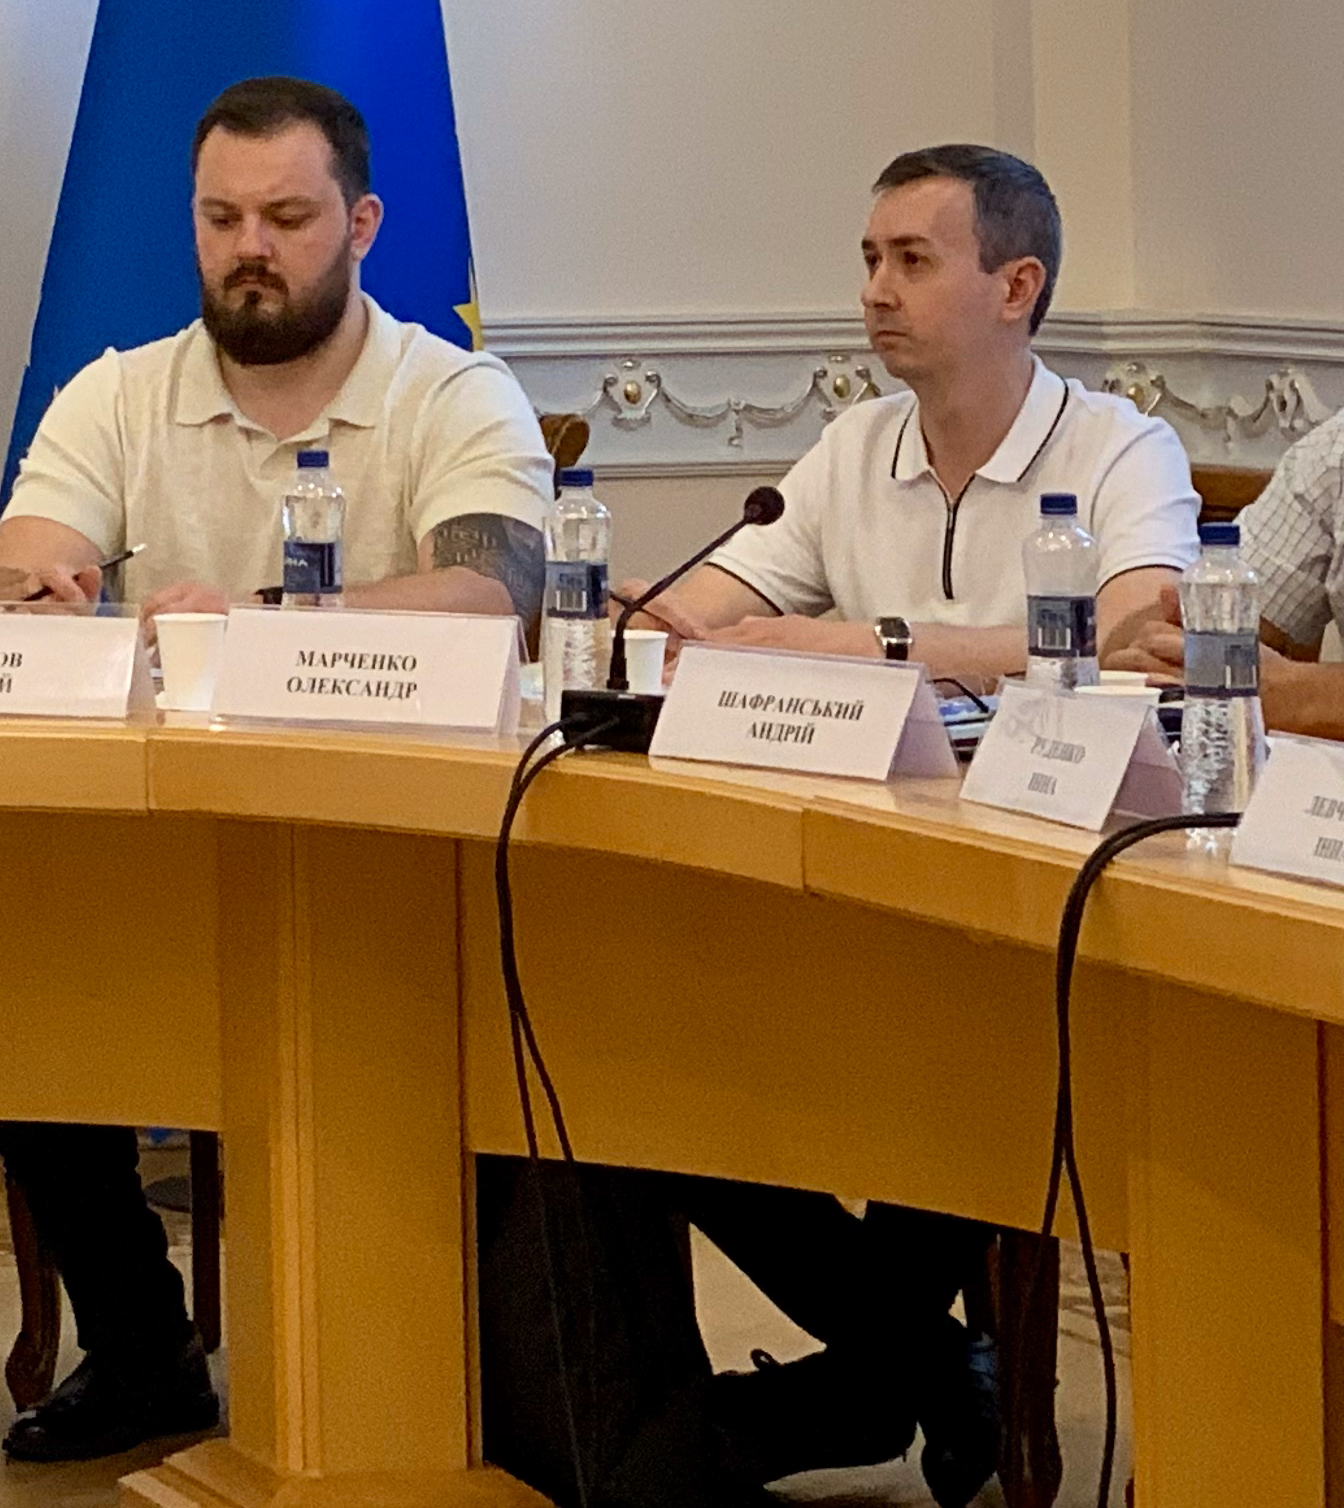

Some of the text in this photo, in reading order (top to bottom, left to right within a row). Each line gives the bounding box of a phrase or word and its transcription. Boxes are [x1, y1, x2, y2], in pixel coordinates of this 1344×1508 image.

[295, 650, 417, 671] МАРЧЕНКО
[286, 676, 418, 700] ОЛЕКСАНДР
[717, 690, 864, 721] ШАФРАНСЬКИЙ
[746, 721, 816, 744] АНДРІЙ
